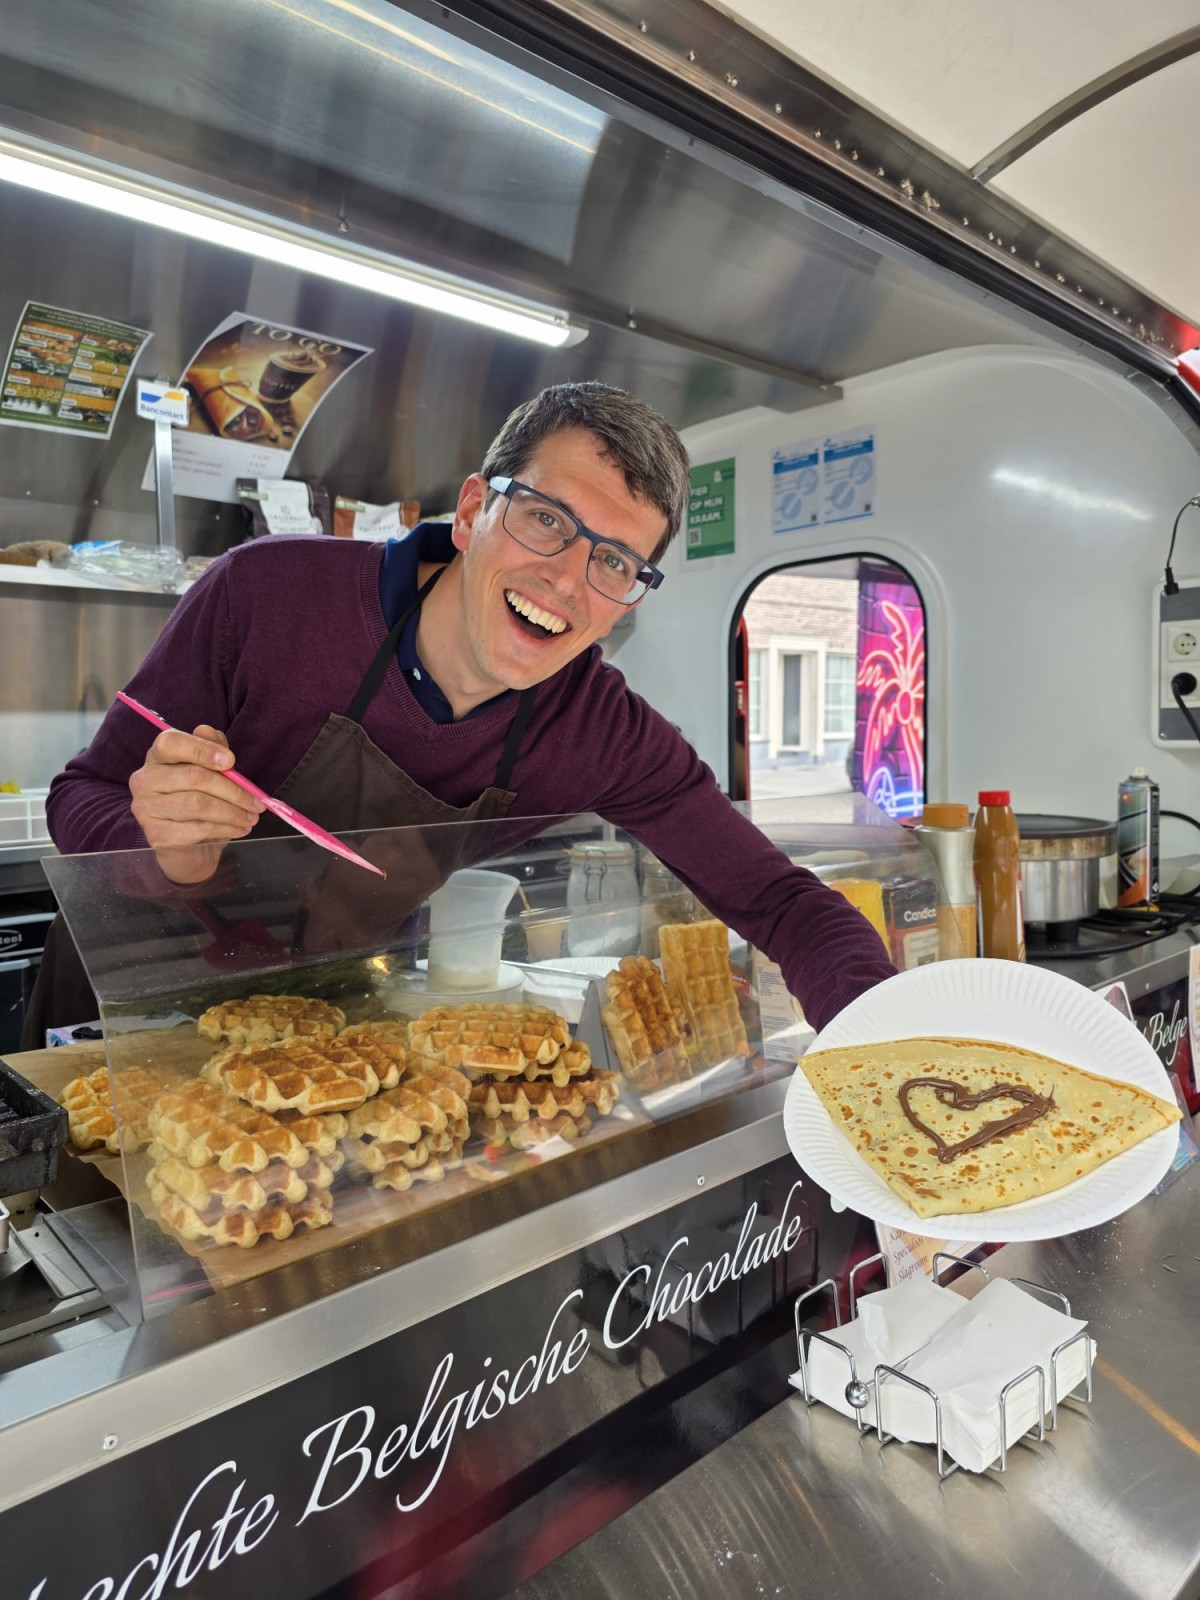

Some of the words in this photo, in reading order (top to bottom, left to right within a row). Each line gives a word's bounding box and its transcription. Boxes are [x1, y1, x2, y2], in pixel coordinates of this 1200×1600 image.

[254, 323, 292, 341] TO
[299, 337, 341, 355] GO
[140, 404, 184, 420] Bancontact
[690, 501, 702, 511] OP
[904, 908, 936, 922] Candico
[1149, 999, 1188, 1067] Belge
[898, 1255, 929, 1282] Slagroom
[295, 1287, 591, 1527] Belgische
[602, 1180, 803, 1350] Chocolade
